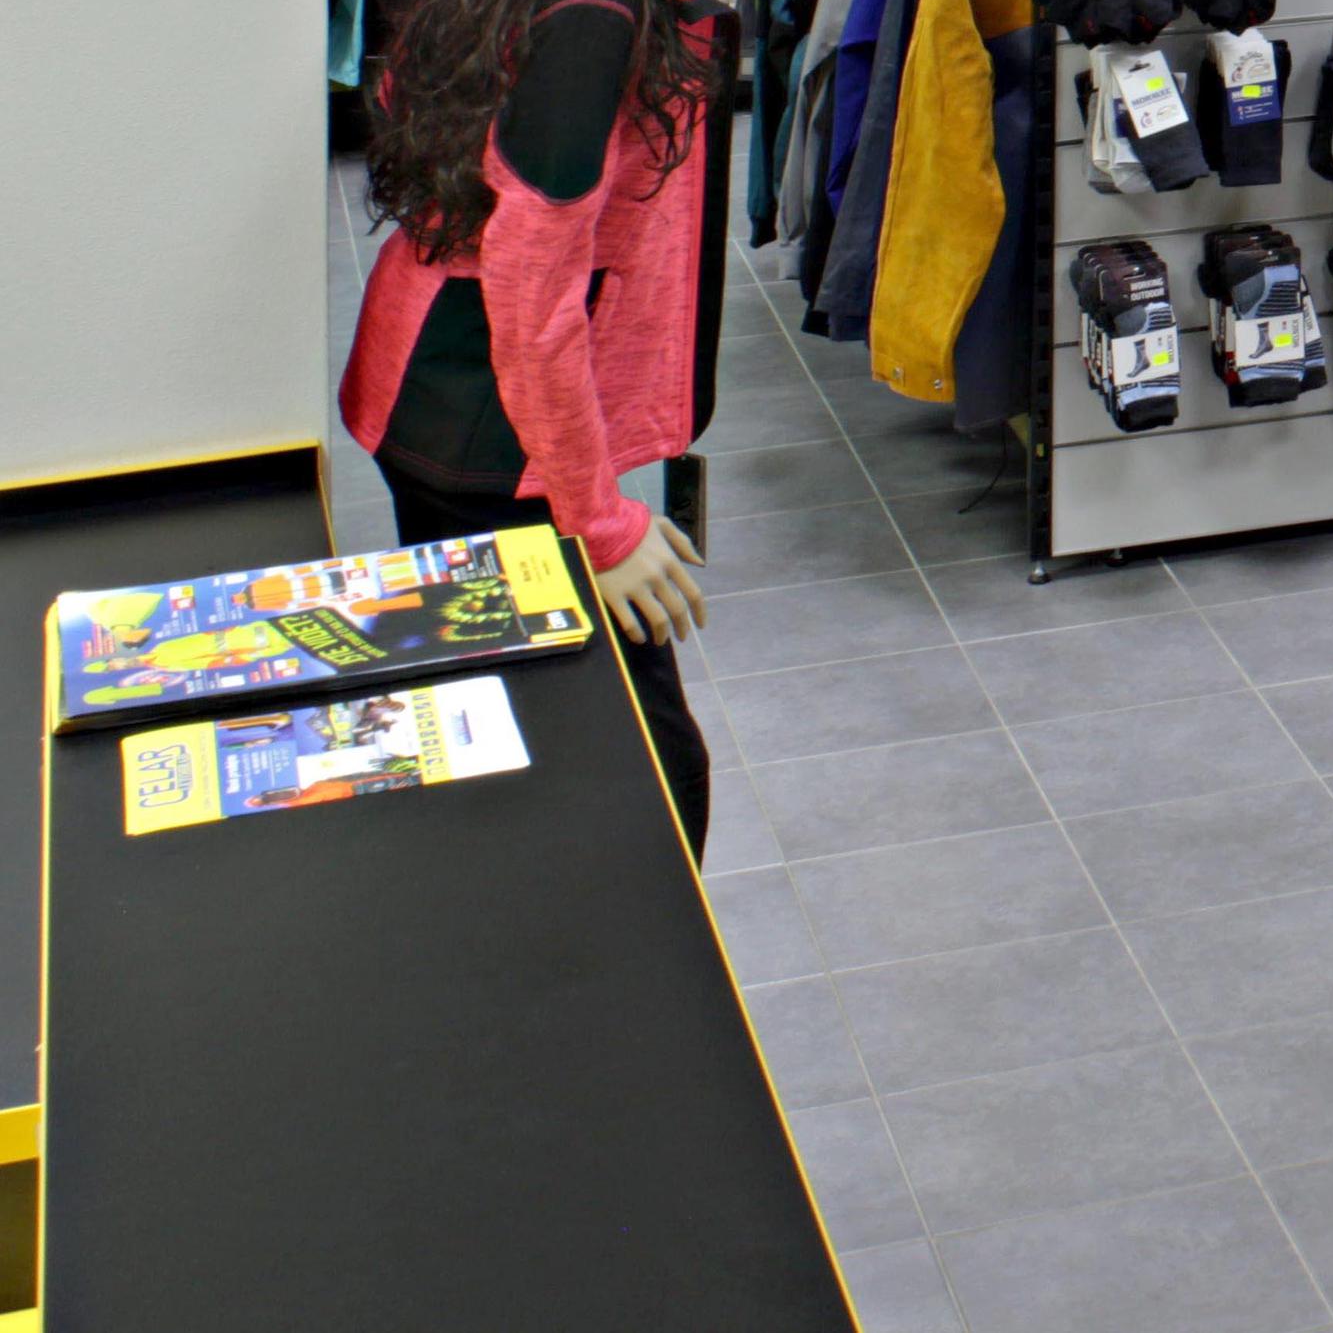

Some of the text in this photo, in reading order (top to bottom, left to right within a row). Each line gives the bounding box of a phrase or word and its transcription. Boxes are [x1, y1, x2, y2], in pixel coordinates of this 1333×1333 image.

[1130, 278, 1164, 291] WORKING
[1130, 288, 1165, 301] OUTDOOR
[138, 744, 190, 808] CELAR
